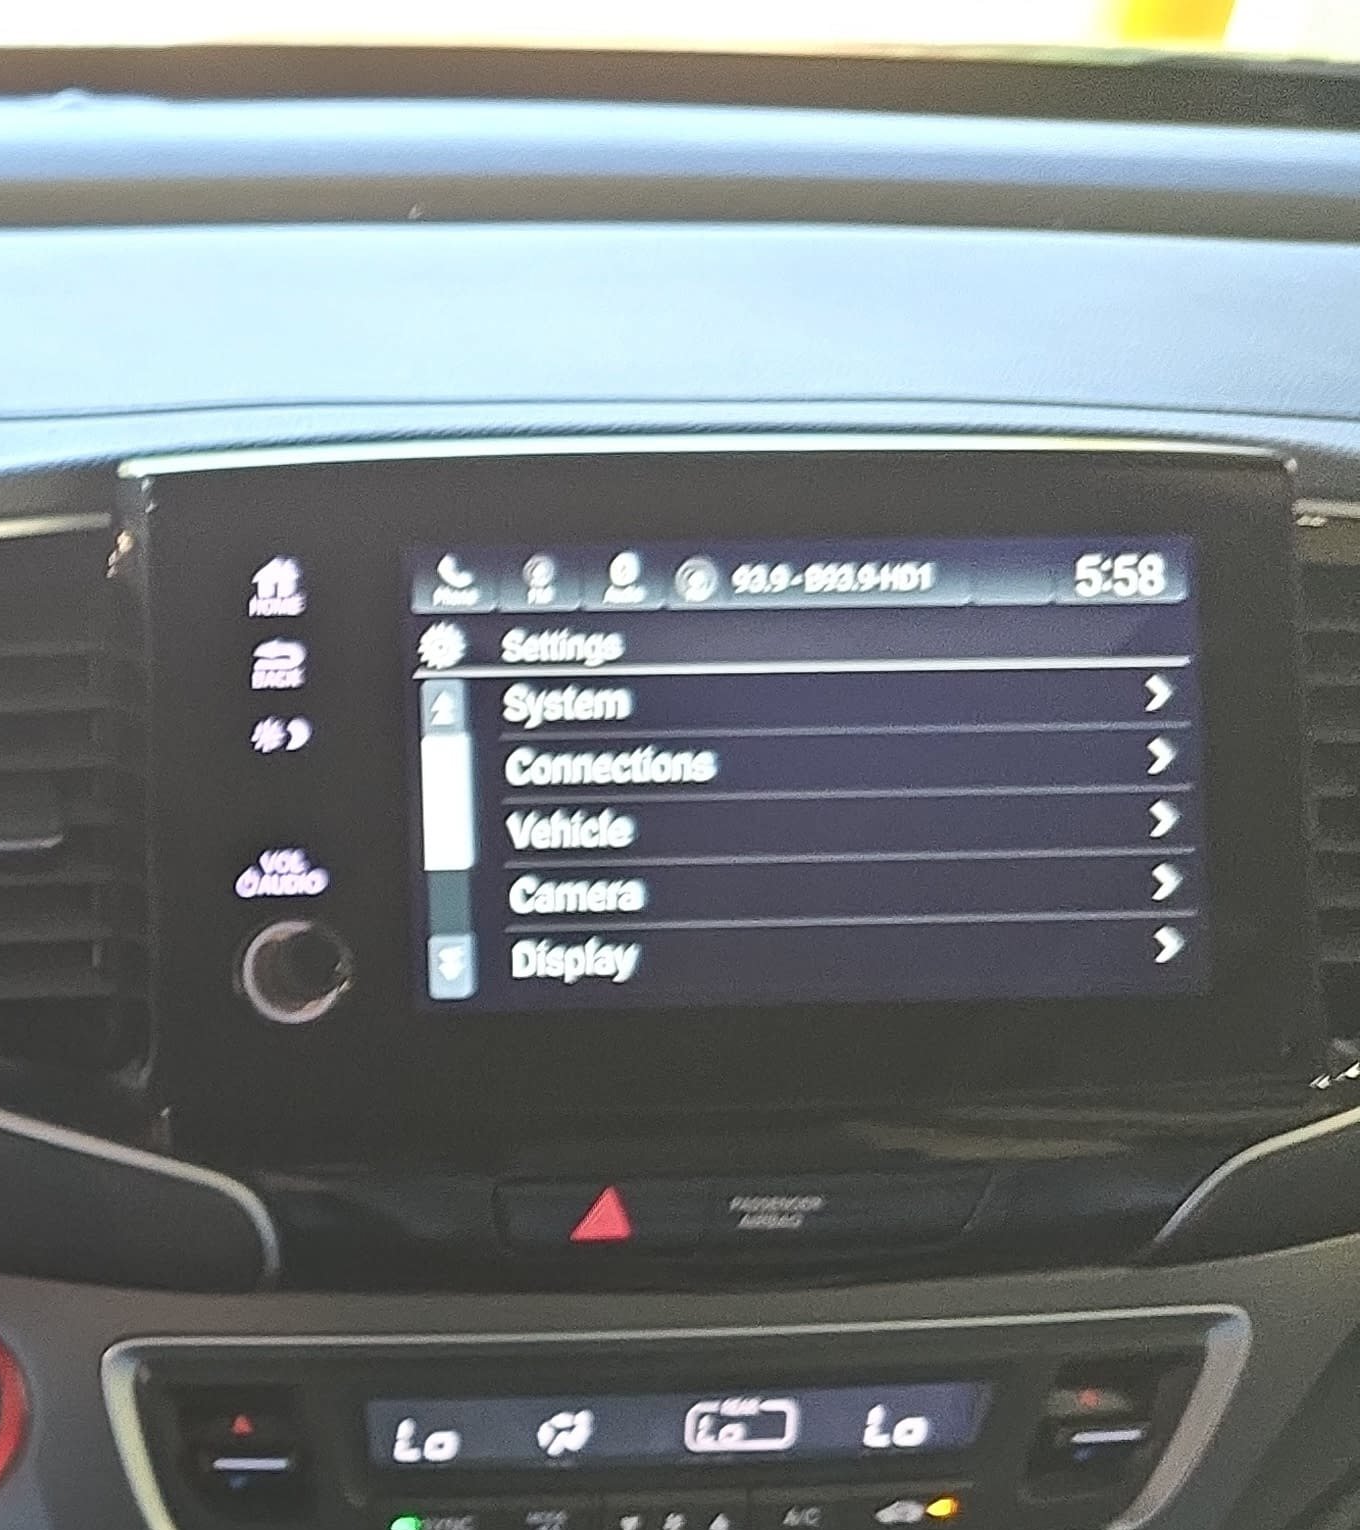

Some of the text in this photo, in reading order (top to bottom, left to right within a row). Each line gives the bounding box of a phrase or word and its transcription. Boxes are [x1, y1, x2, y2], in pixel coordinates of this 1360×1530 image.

[1074, 553, 1166, 599] 5:58
[501, 628, 625, 667] Settings
[503, 681, 632, 729] System
[505, 745, 719, 786] Connections
[506, 807, 636, 850] Vehicle
[509, 874, 647, 915] Camera
[511, 935, 641, 984] Display
[393, 1417, 462, 1463] Lo
[863, 1403, 930, 1449] Lo
